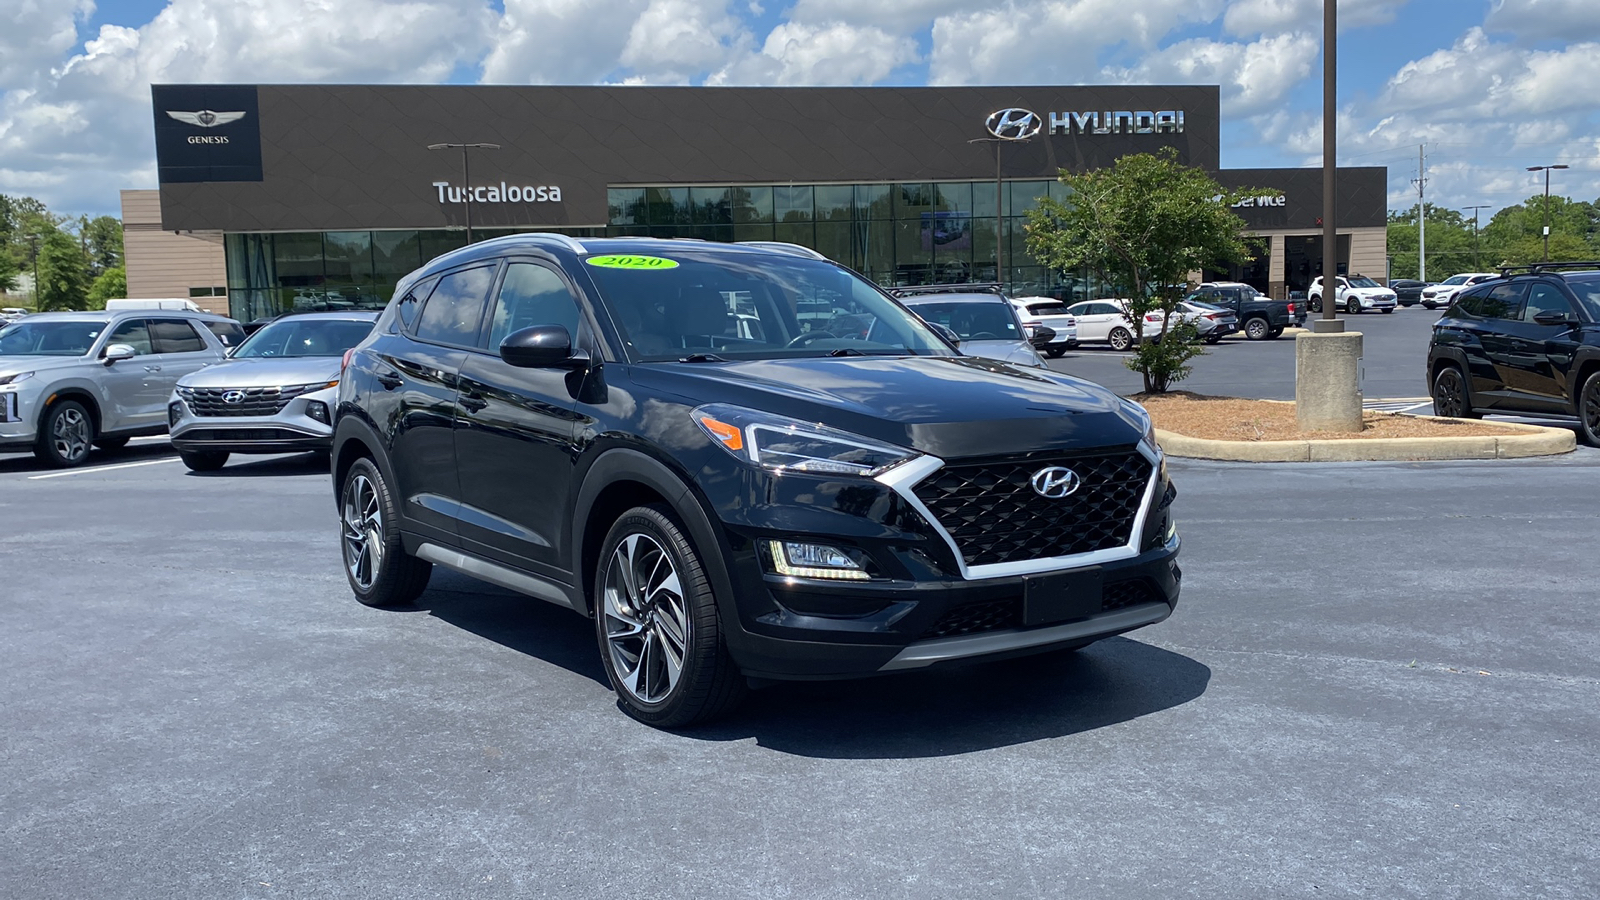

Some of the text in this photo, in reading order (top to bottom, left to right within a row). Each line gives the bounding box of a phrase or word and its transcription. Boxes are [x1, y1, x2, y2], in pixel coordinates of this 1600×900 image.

[1049, 110, 1185, 135] HYUNDAI
[187, 136, 229, 144] GENESIS
[432, 181, 562, 203] Tuscaloosa
[603, 257, 663, 266] 2020
